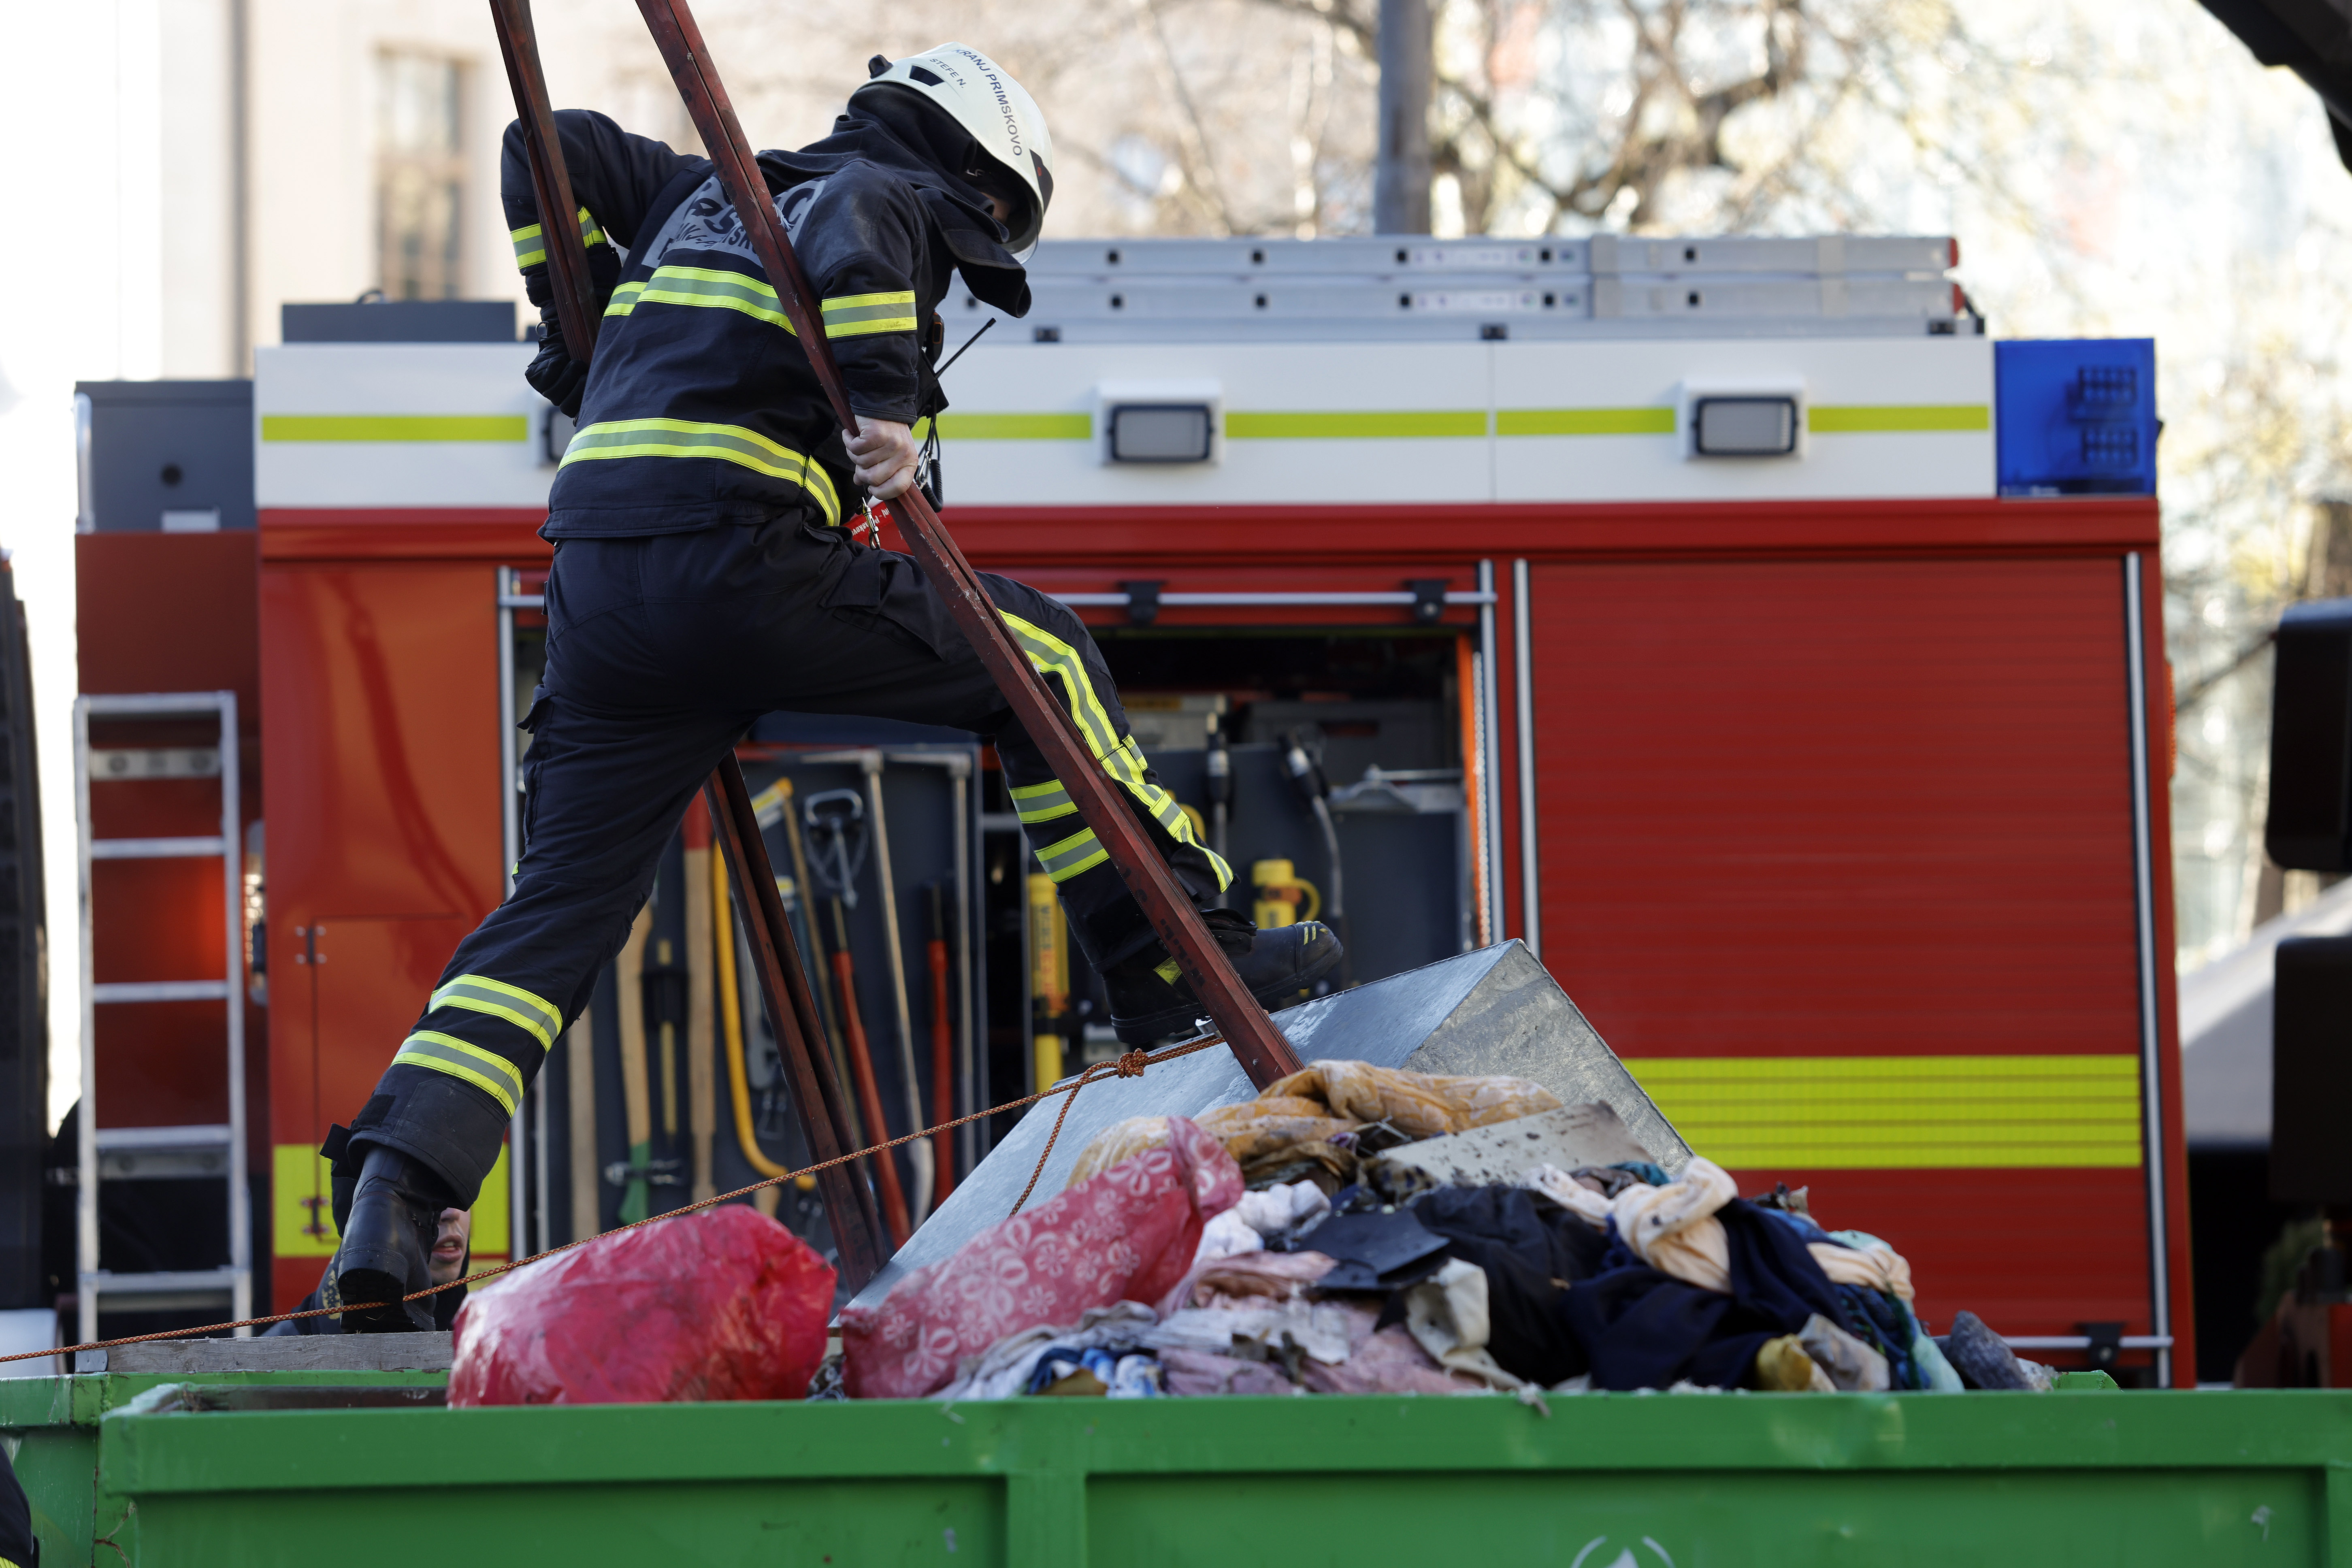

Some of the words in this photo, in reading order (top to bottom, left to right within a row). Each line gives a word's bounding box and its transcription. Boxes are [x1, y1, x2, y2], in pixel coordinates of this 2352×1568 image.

[929, 58, 960, 78] STEFE
[957, 78, 966, 88] N.
[951, 49, 991, 71] KRANJ
[985, 74, 1023, 156] PRIMSKOVO
